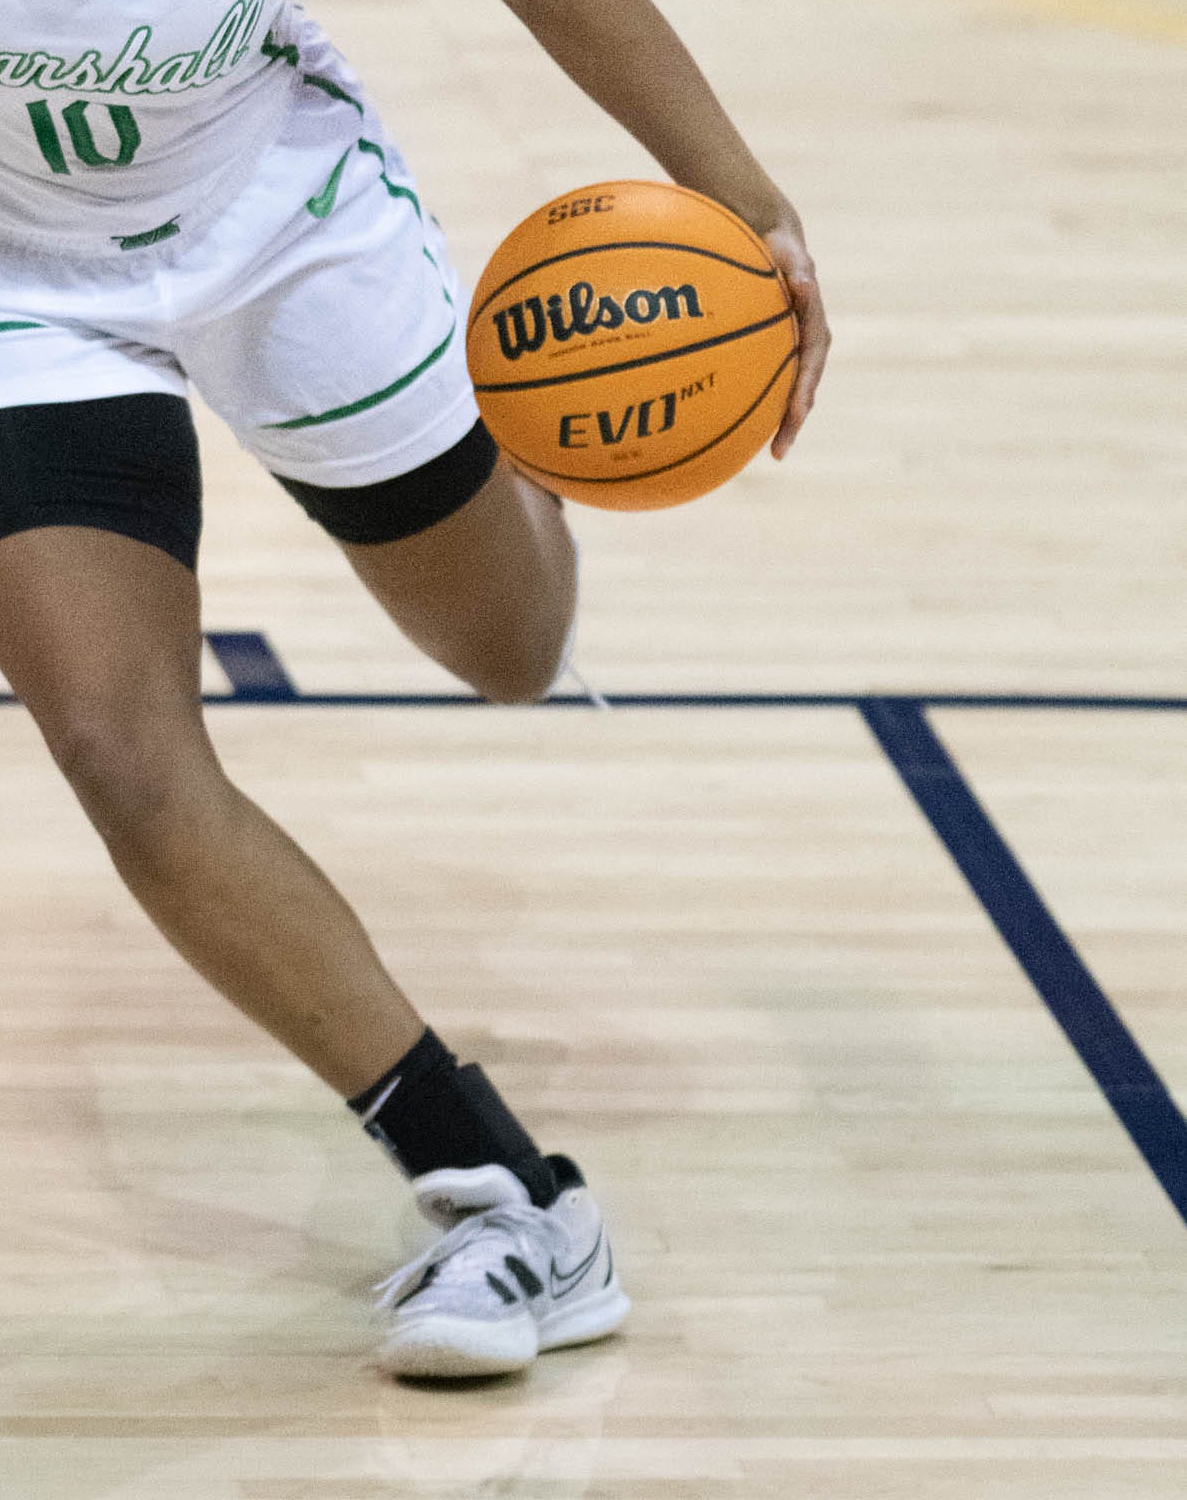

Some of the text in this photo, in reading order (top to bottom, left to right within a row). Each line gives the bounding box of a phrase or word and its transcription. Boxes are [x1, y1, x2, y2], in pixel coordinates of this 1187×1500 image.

[26, 100, 142, 175] 10
[548, 194, 616, 225] SBC
[493, 281, 703, 361] Wilson
[559, 391, 677, 449] EVO
